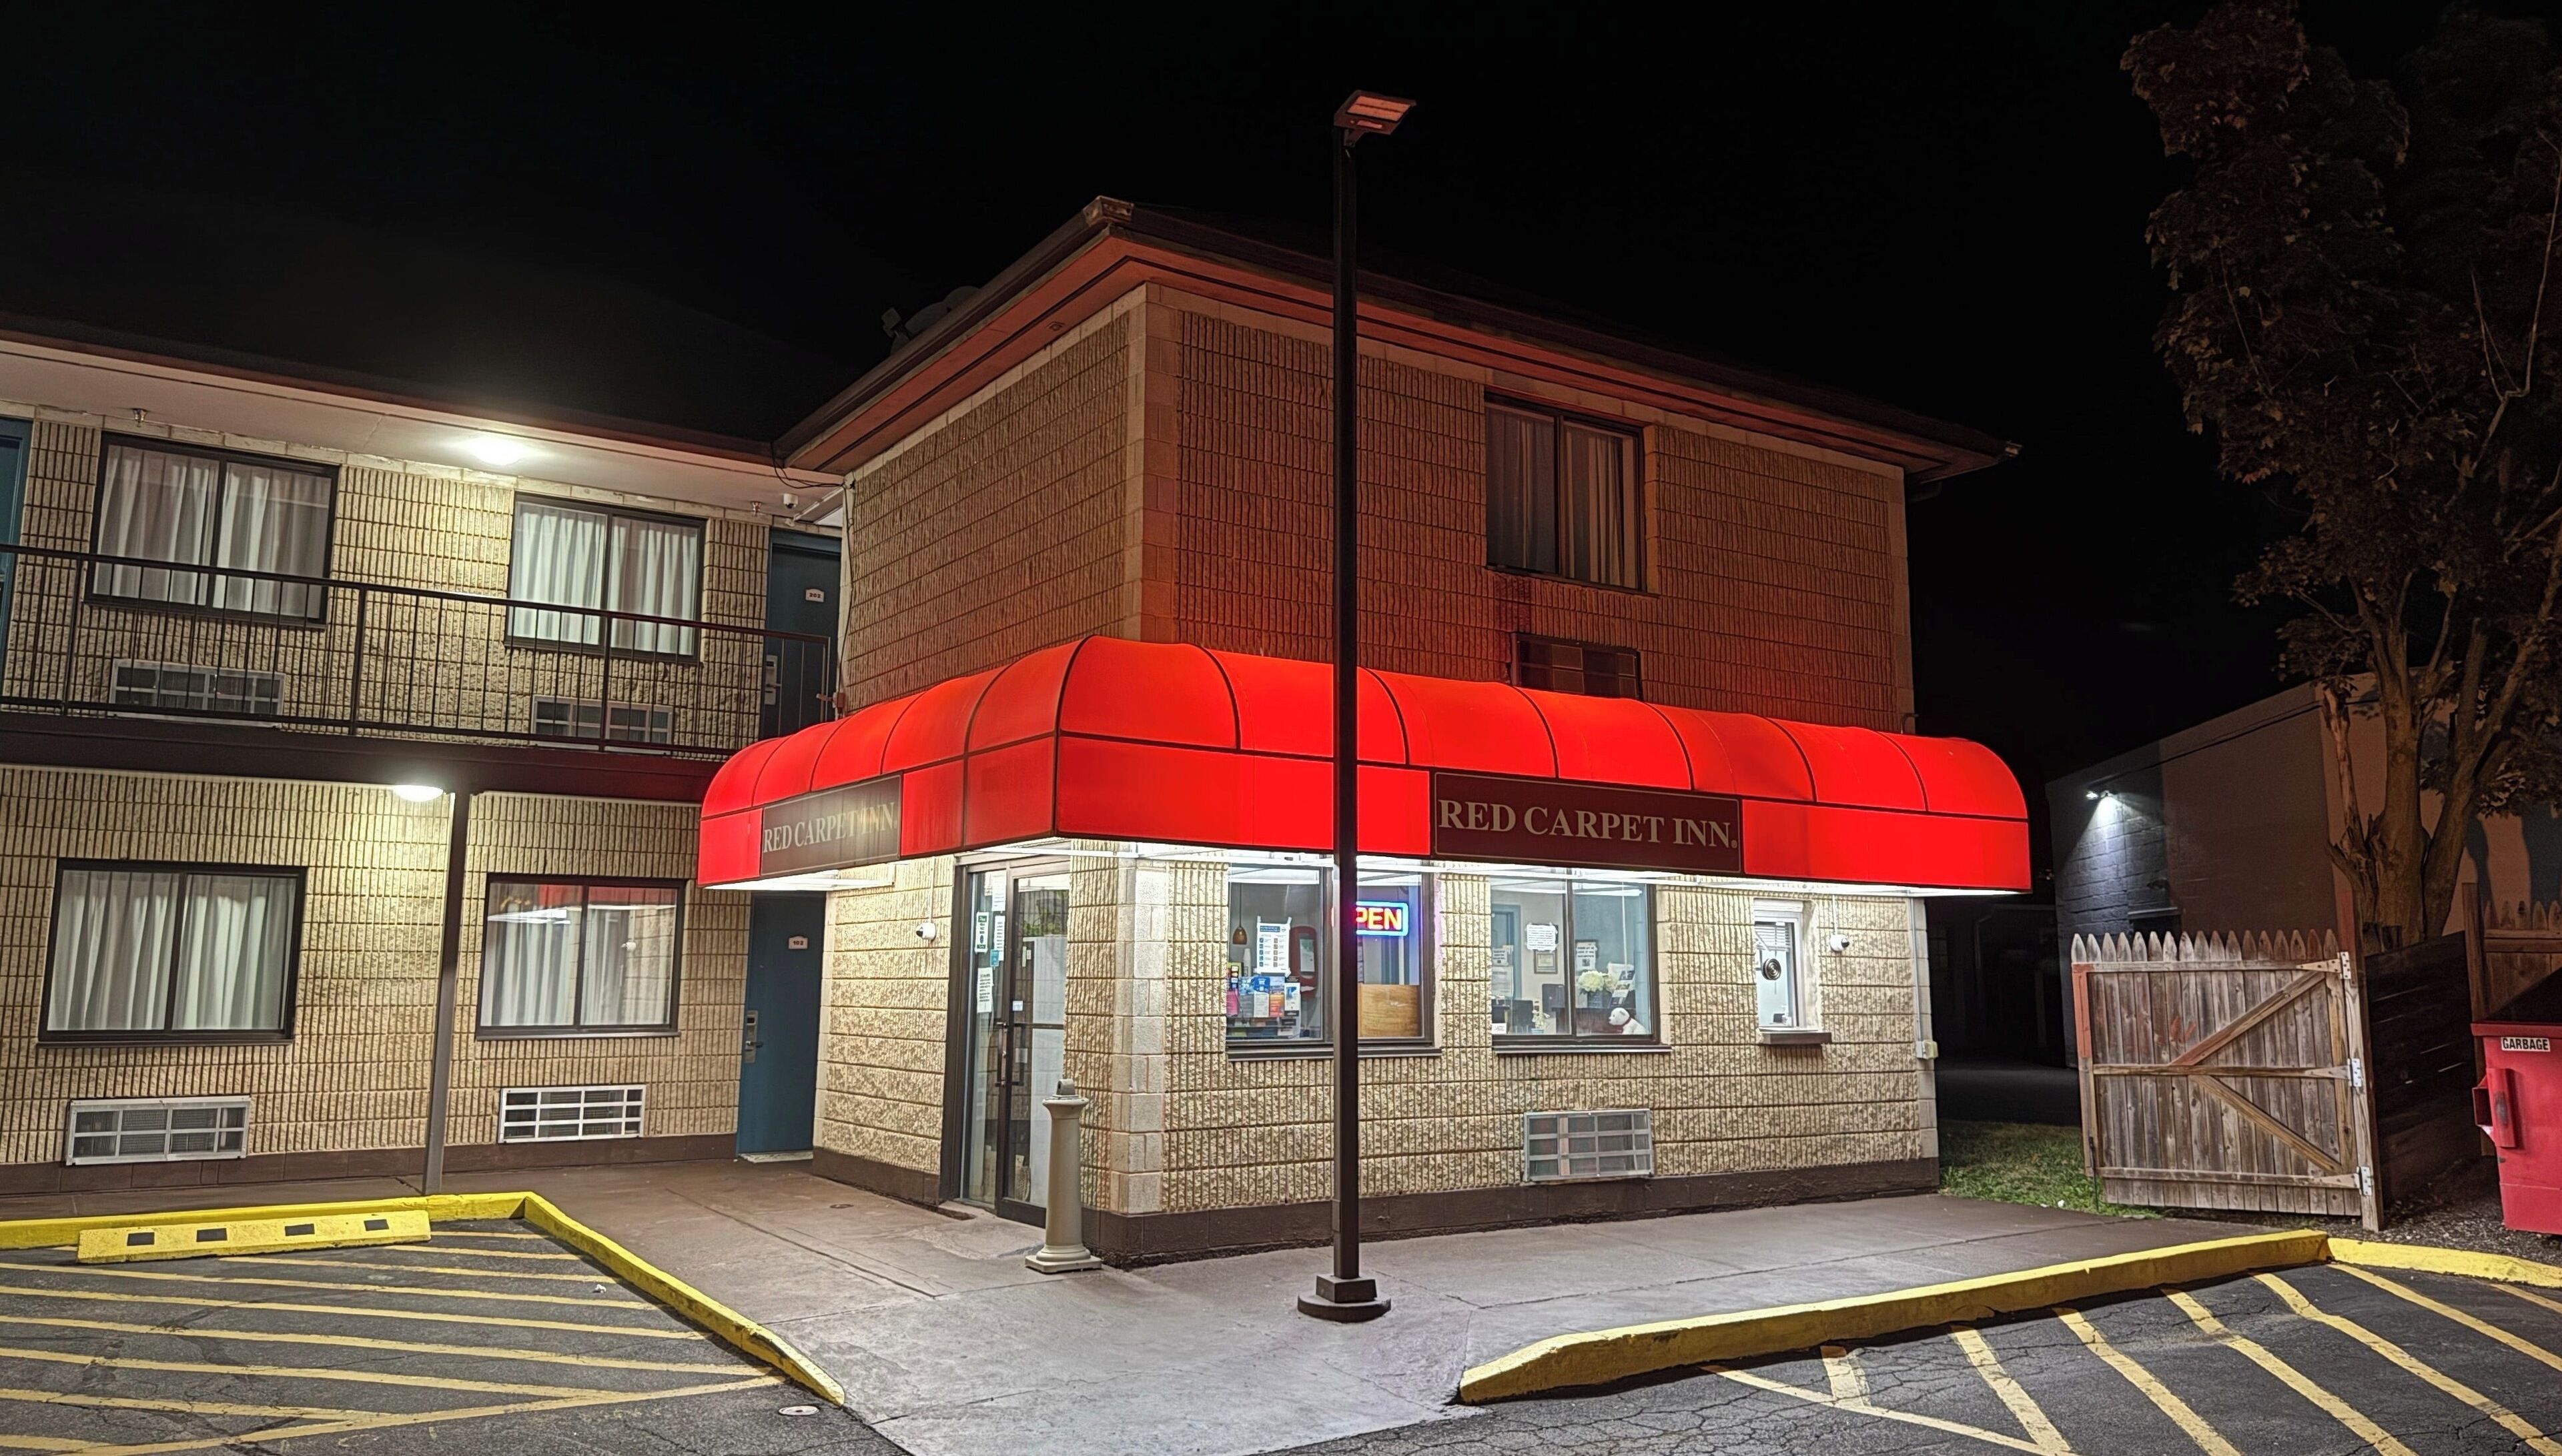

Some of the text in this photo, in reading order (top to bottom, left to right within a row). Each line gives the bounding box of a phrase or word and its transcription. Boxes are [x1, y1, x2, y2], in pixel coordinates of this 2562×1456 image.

[763, 824, 792, 853] RED
[794, 809, 859, 847] CARPET
[1438, 799, 1516, 832] RED
[1524, 806, 1665, 843] CARPET
[1331, 906, 1402, 930] PEN
[2502, 1037, 2549, 1050] GARBAGE
